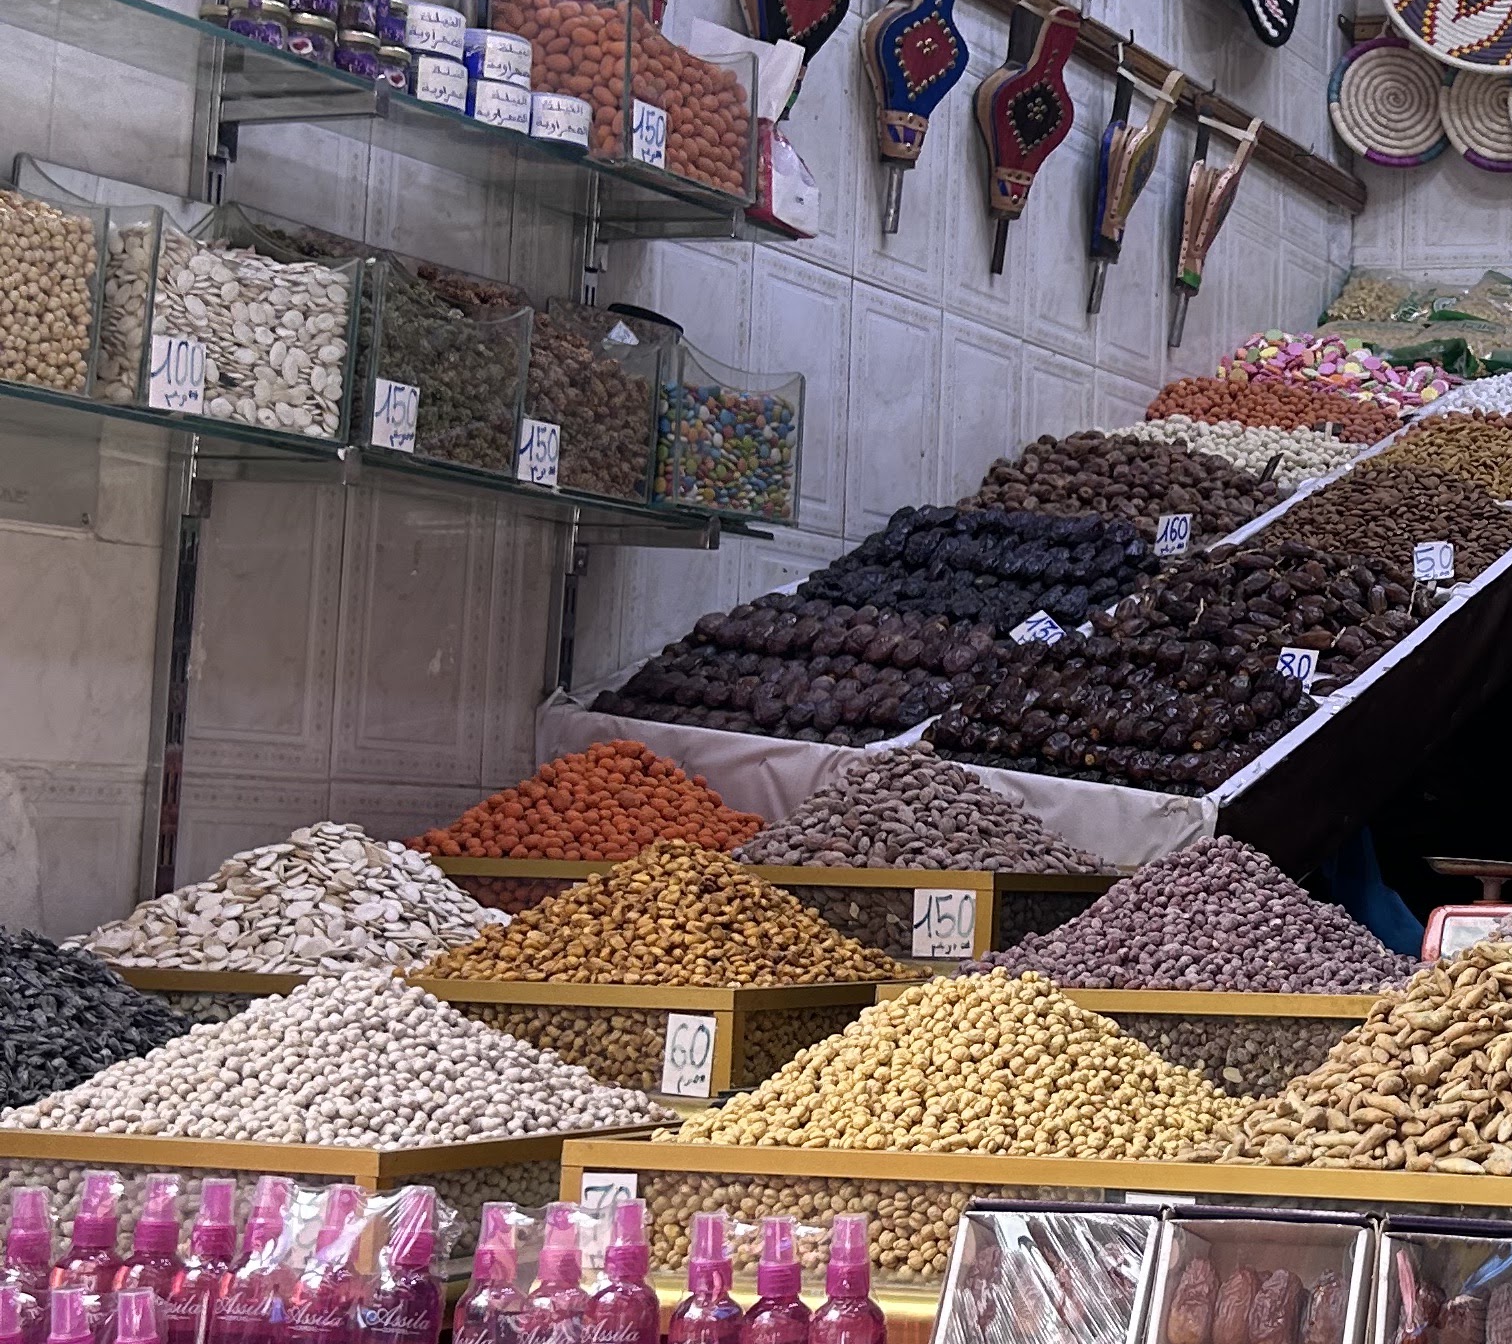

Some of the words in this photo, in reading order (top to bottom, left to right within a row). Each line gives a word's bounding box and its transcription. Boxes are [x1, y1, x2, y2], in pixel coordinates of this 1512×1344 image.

[633, 106, 665, 147] 150
[151, 339, 204, 385] 100
[375, 383, 417, 428] 150
[519, 425, 558, 462] 150
[1157, 516, 1188, 543] 160
[1415, 546, 1452, 572] 50
[1280, 654, 1311, 681] 80
[914, 895, 975, 938] 150
[671, 1024, 710, 1069] 60
[286, 1301, 346, 1328] Assila
[367, 1300, 430, 1329] Assila
[580, 1319, 640, 1343] Assila
